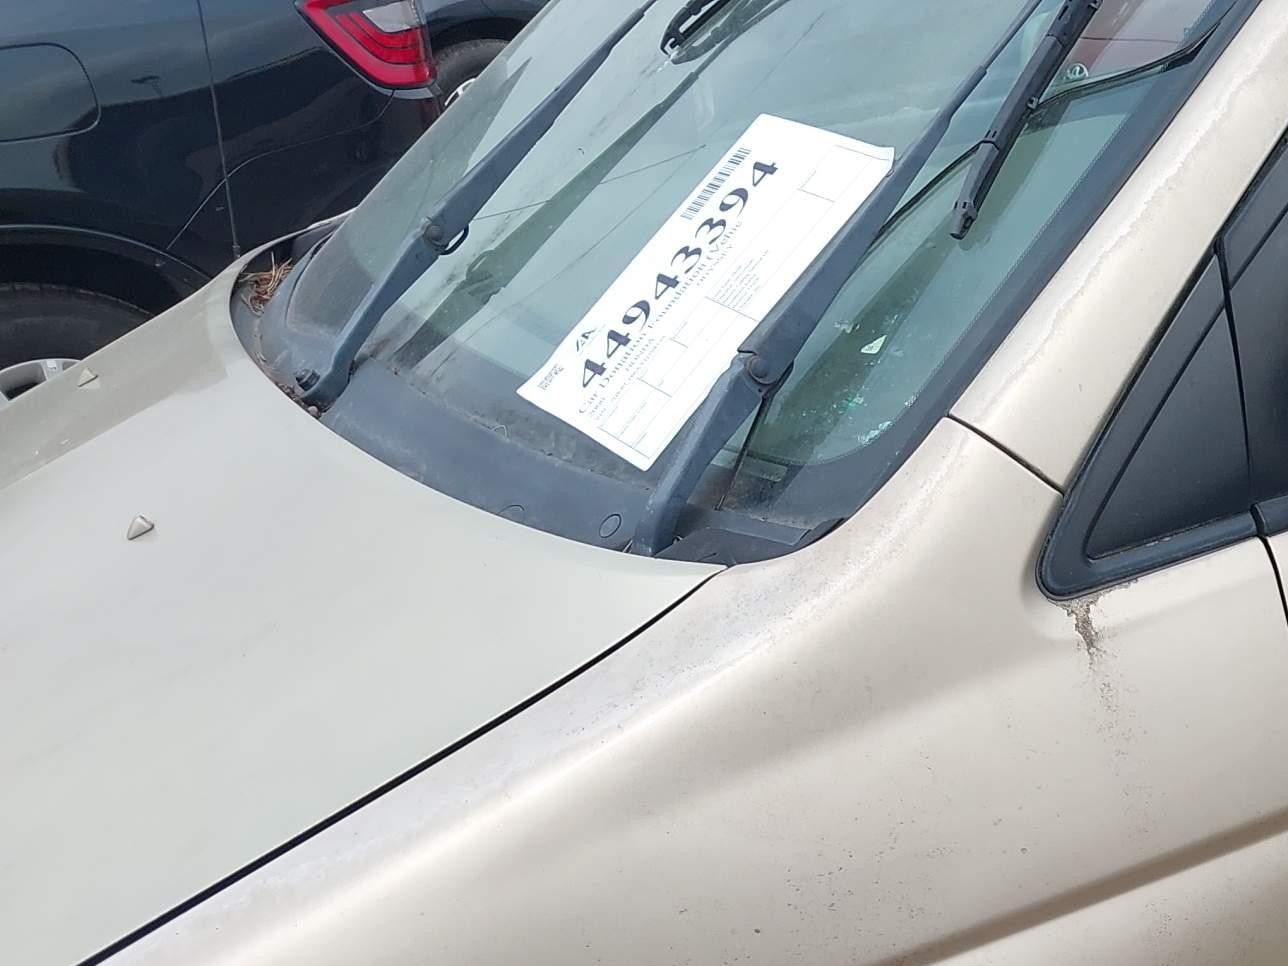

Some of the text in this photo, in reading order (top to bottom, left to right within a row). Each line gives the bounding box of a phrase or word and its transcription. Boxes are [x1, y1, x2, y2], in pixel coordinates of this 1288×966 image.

[582, 160, 778, 388] 44943394
[599, 333, 646, 388] Donation
[648, 263, 706, 328] Foundation
